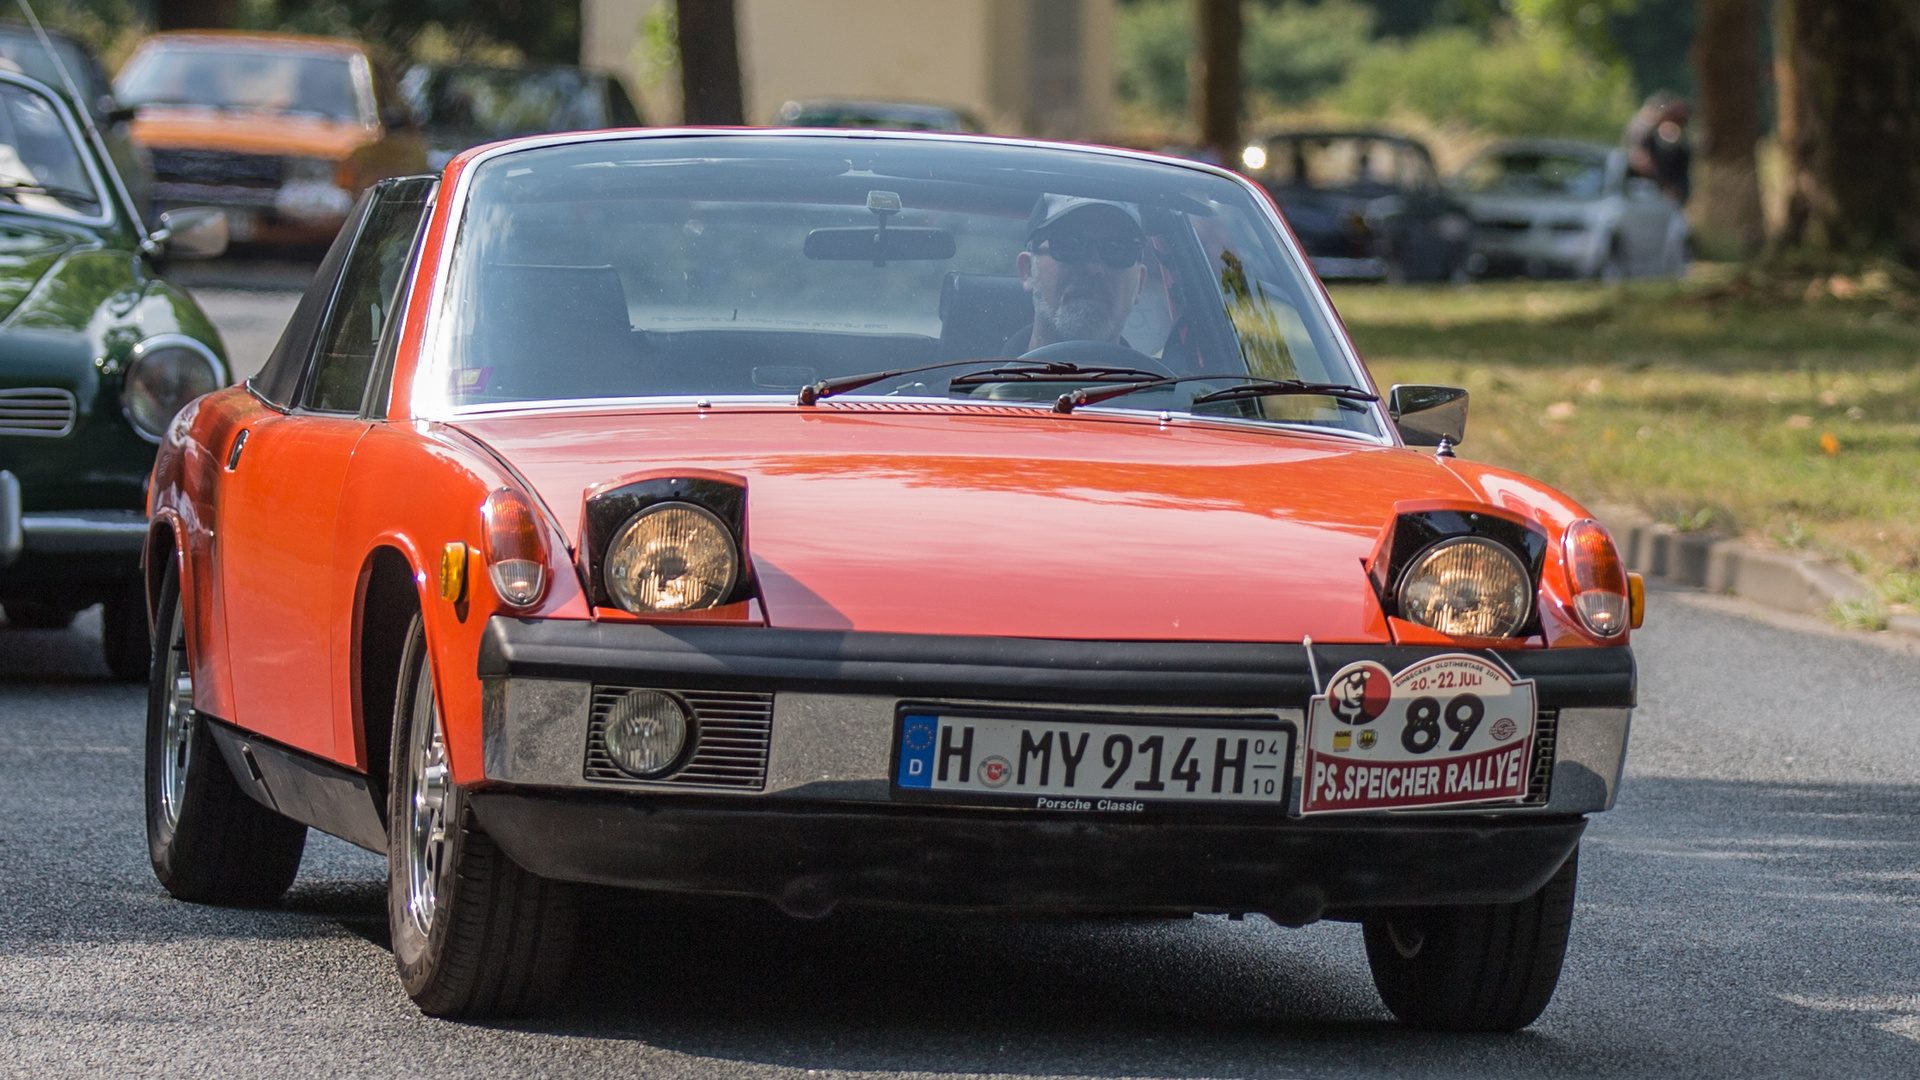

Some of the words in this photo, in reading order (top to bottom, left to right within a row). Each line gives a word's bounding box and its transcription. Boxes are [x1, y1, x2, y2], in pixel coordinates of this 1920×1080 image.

[1435, 661, 1484, 673] OLDTIMERTAGE
[1401, 693, 1485, 754] 89
[1254, 738, 1278, 754] 04
[908, 758, 923, 775] D
[937, 725, 974, 782] H
[1016, 729, 1090, 787] MY
[1312, 761, 1440, 801] PS.SPEICHER
[1444, 748, 1522, 794] RALLYE
[1253, 778, 1275, 795] 10
[1036, 797, 1092, 810] Porsche
[1096, 800, 1145, 812] Classic
